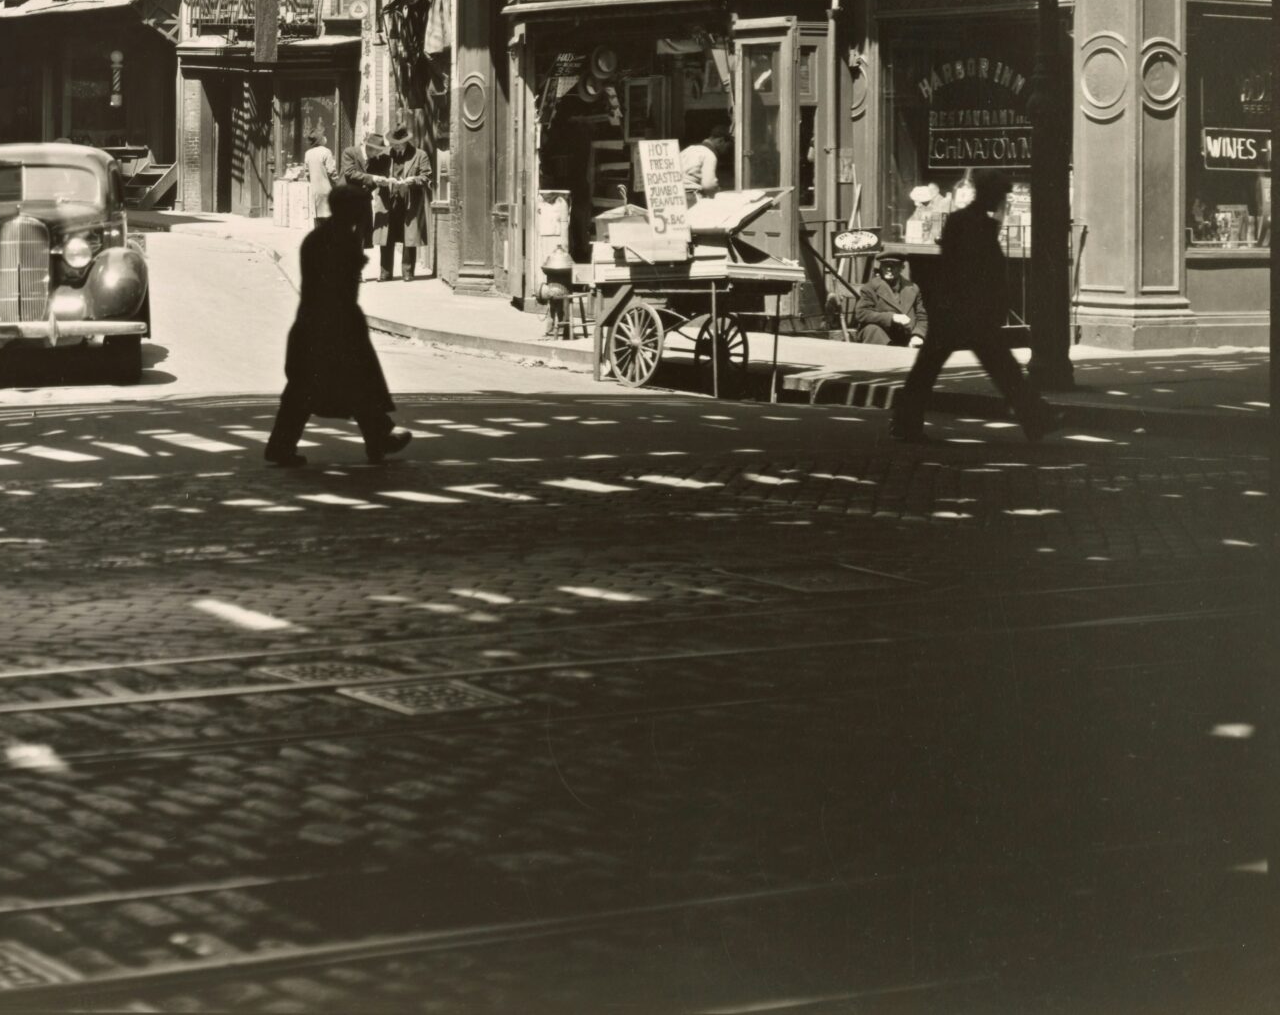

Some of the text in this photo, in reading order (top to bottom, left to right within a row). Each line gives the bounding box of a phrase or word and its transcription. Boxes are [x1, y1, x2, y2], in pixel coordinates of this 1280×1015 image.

[919, 58, 1027, 104] HARBOR INN
[928, 109, 1016, 126] RESTAURANT
[649, 142, 670, 156] HOT
[1206, 136, 1257, 160] WINES
[649, 158, 675, 170] FRESH
[646, 171, 683, 185] ROASTED
[650, 185, 679, 198] JUMBO
[649, 196, 686, 208] PEANUTS
